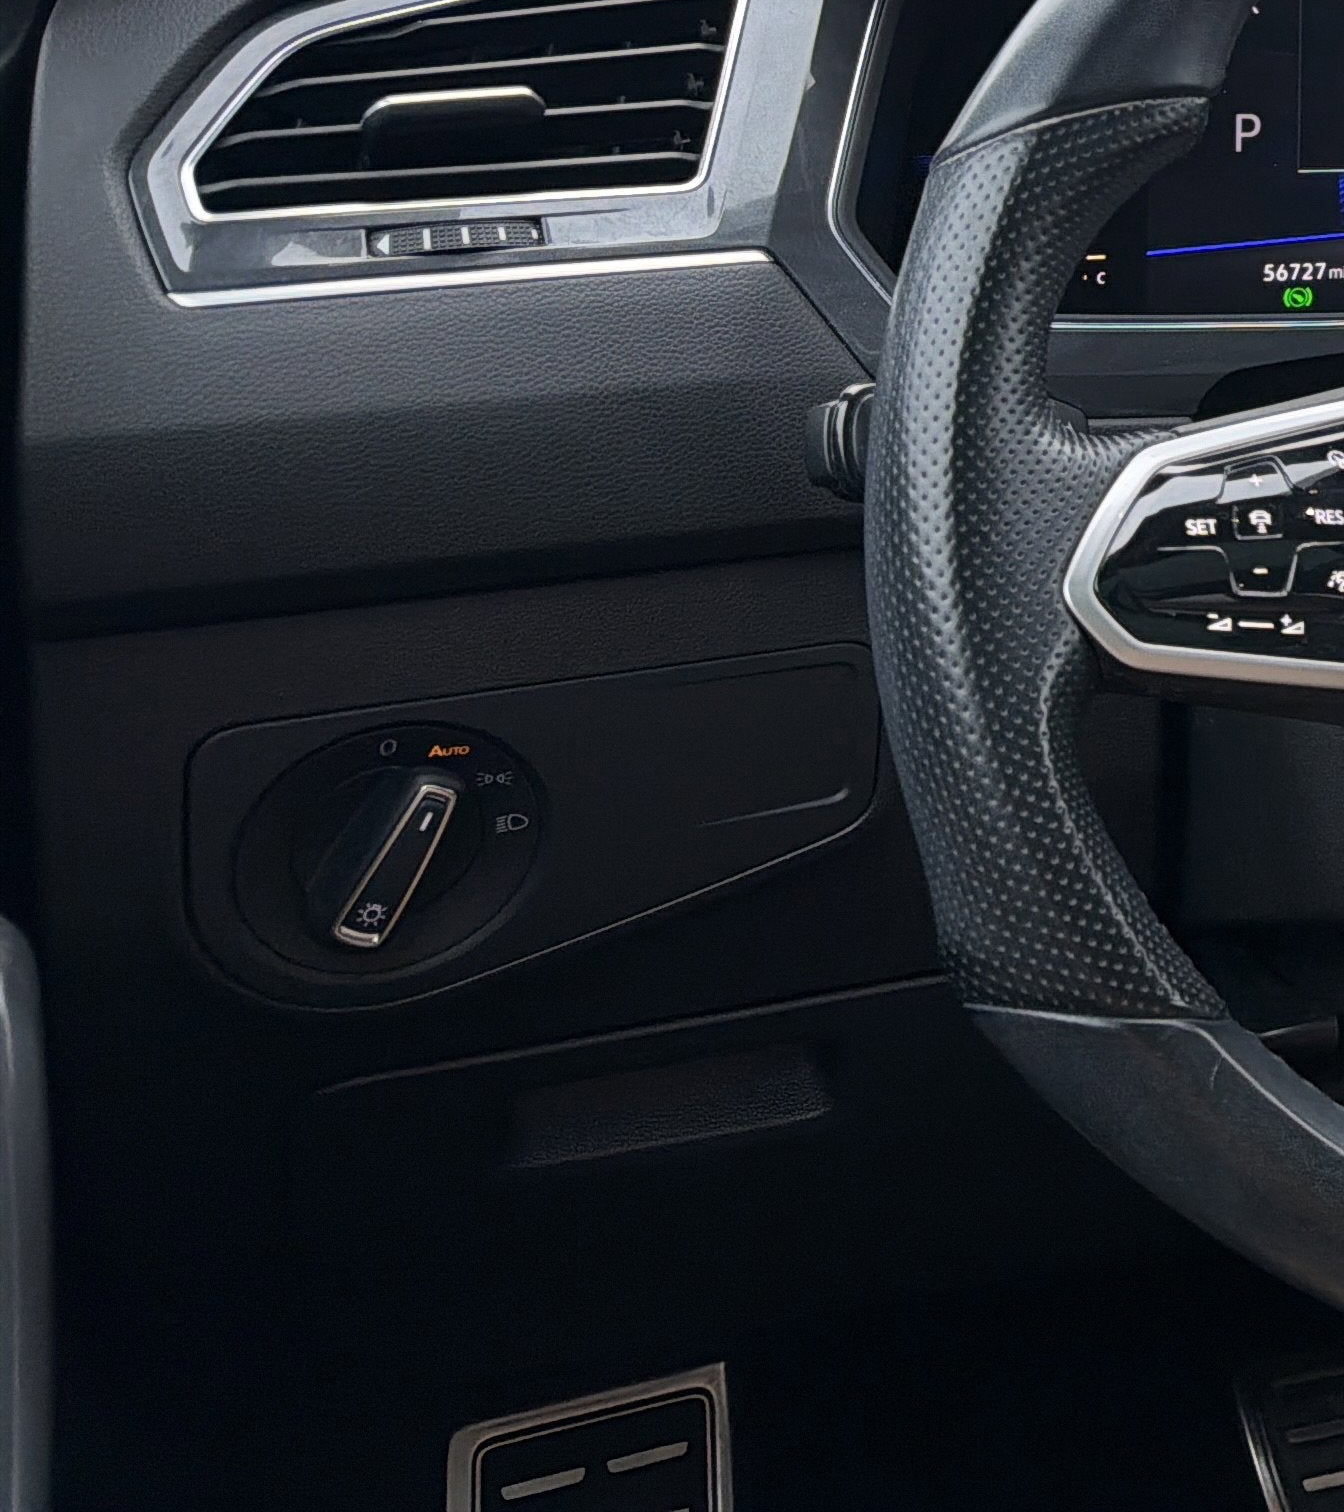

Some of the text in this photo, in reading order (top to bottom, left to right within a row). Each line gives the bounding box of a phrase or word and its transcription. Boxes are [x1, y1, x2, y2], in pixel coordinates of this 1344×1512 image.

[1235, 113, 1262, 153] P
[1263, 262, 1327, 282] 56727
[1314, 508, 1344, 526] RES
[1185, 518, 1218, 537] SET
